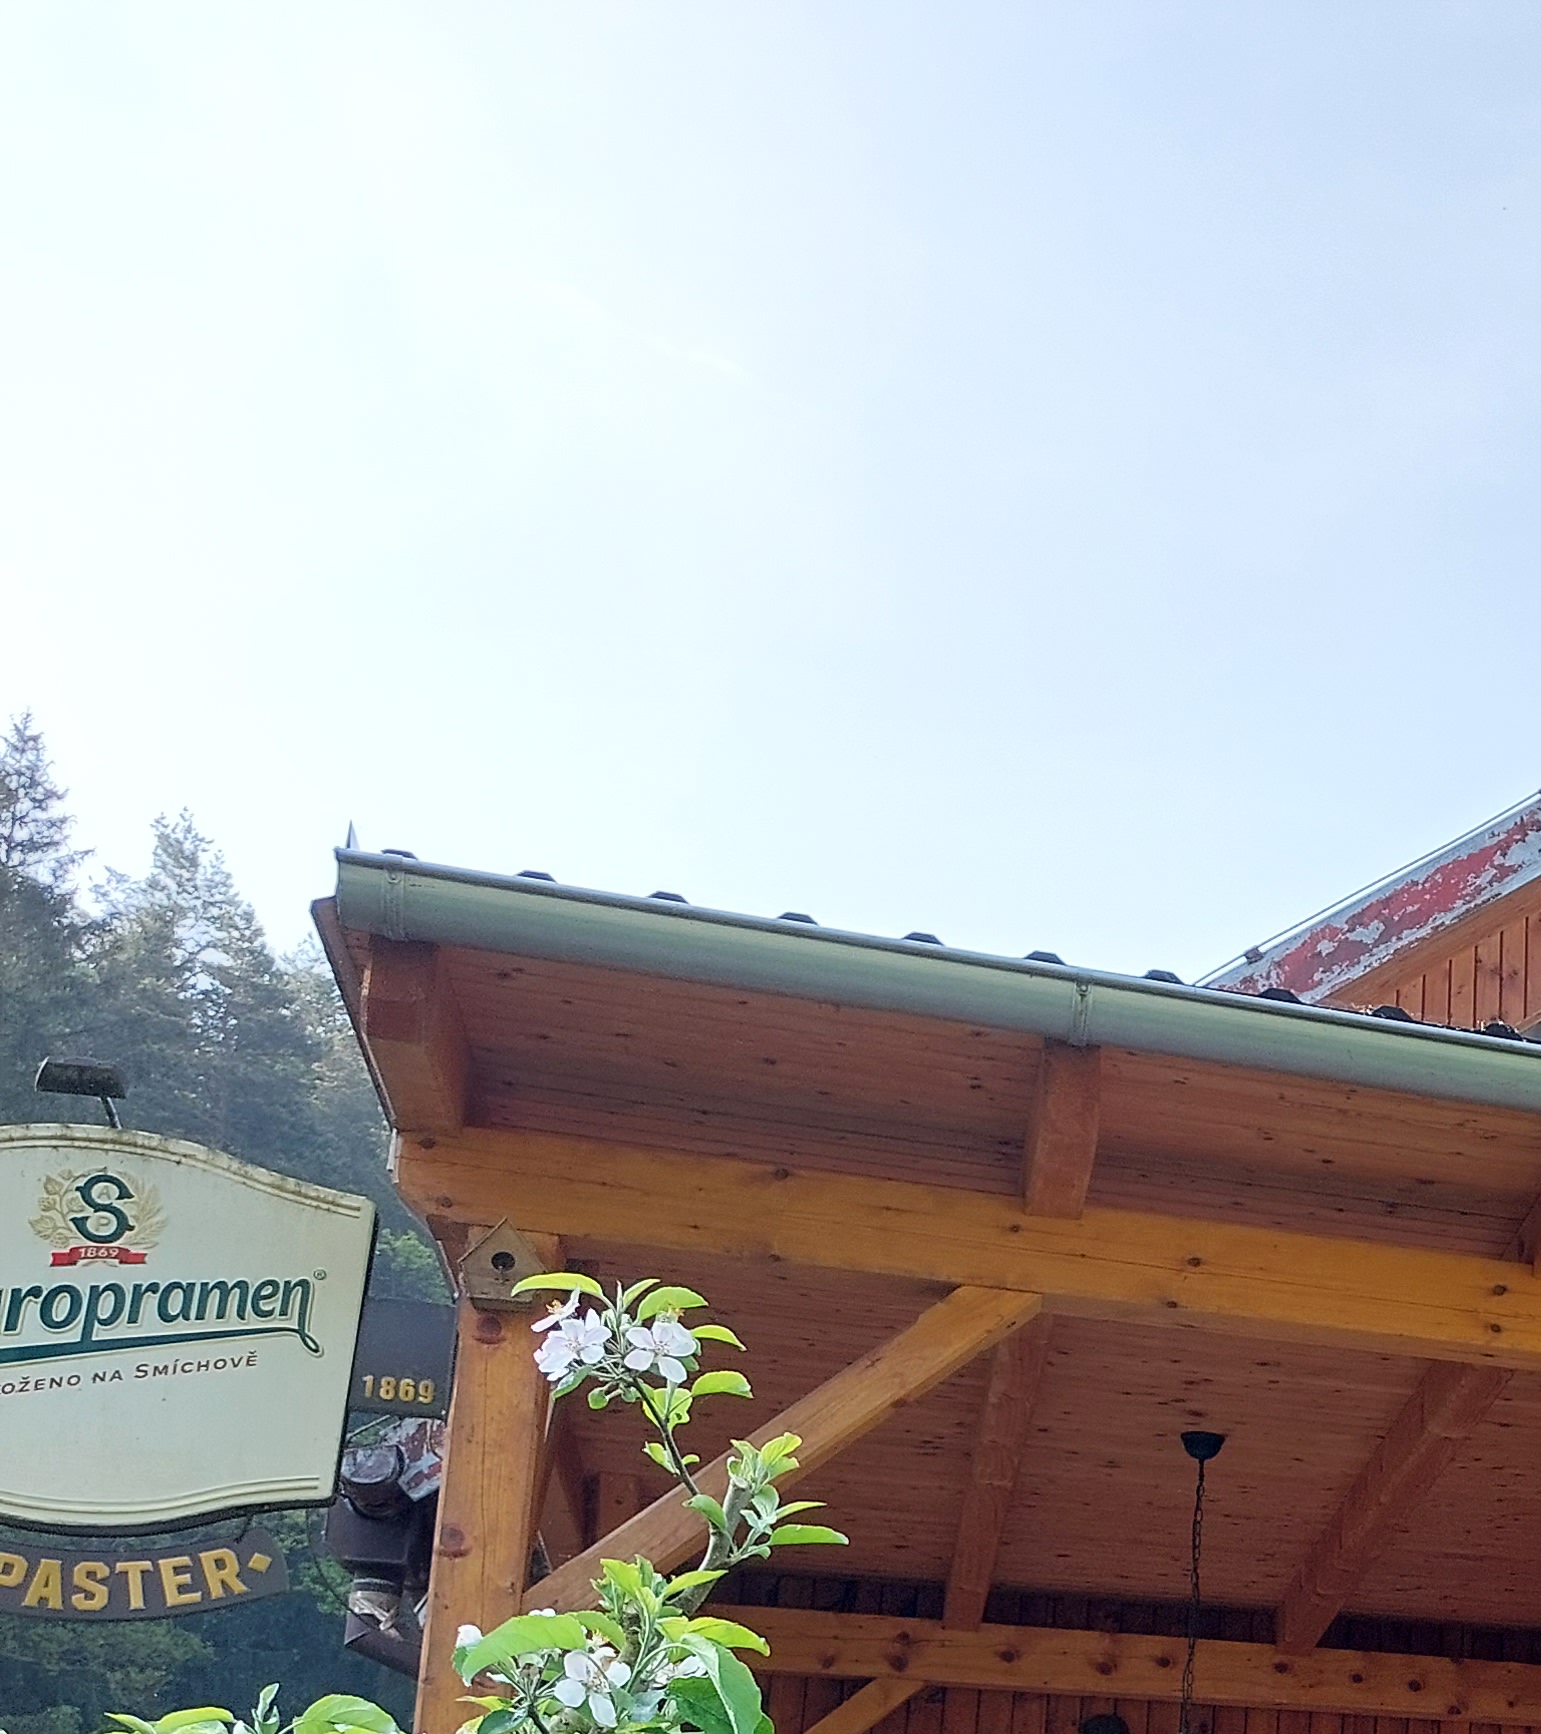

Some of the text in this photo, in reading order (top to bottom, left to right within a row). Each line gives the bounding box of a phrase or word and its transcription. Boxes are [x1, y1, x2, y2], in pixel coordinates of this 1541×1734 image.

[78, 1247, 119, 1258] 1869
[0, 1277, 321, 1362] ropramen
[0, 1375, 81, 1395] OŽENO
[92, 1370, 123, 1384] NA
[362, 1375, 435, 1404] 1869
[0, 1548, 250, 1611] PASTER
